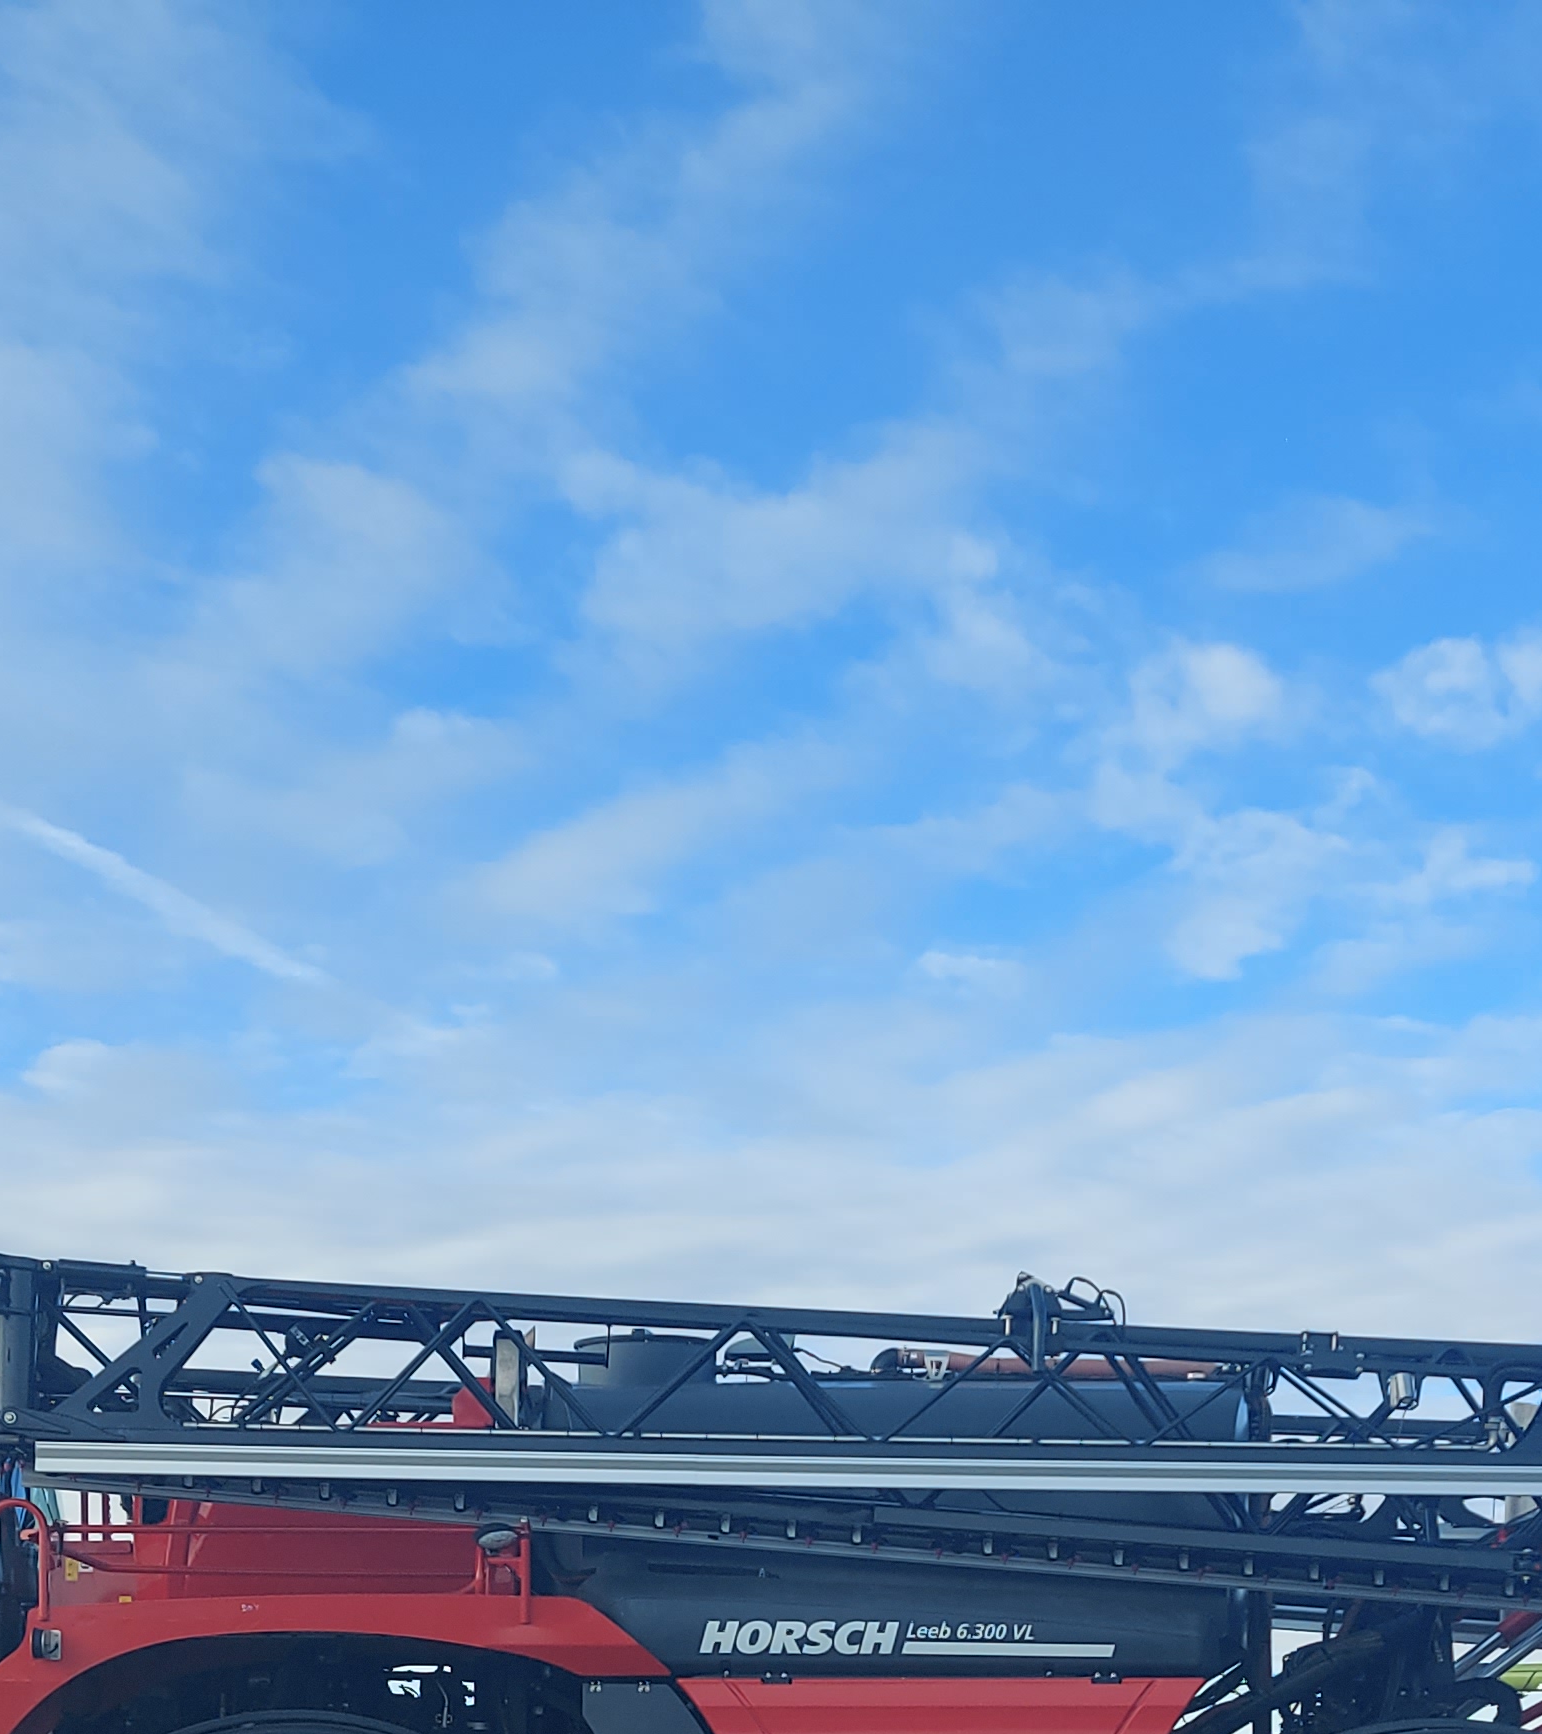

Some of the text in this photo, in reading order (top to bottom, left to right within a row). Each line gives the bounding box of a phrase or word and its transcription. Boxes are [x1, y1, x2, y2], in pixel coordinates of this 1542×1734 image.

[699, 1620, 899, 1655] HORSCH
[906, 1621, 1035, 1641] Leeb 6.300 VL
